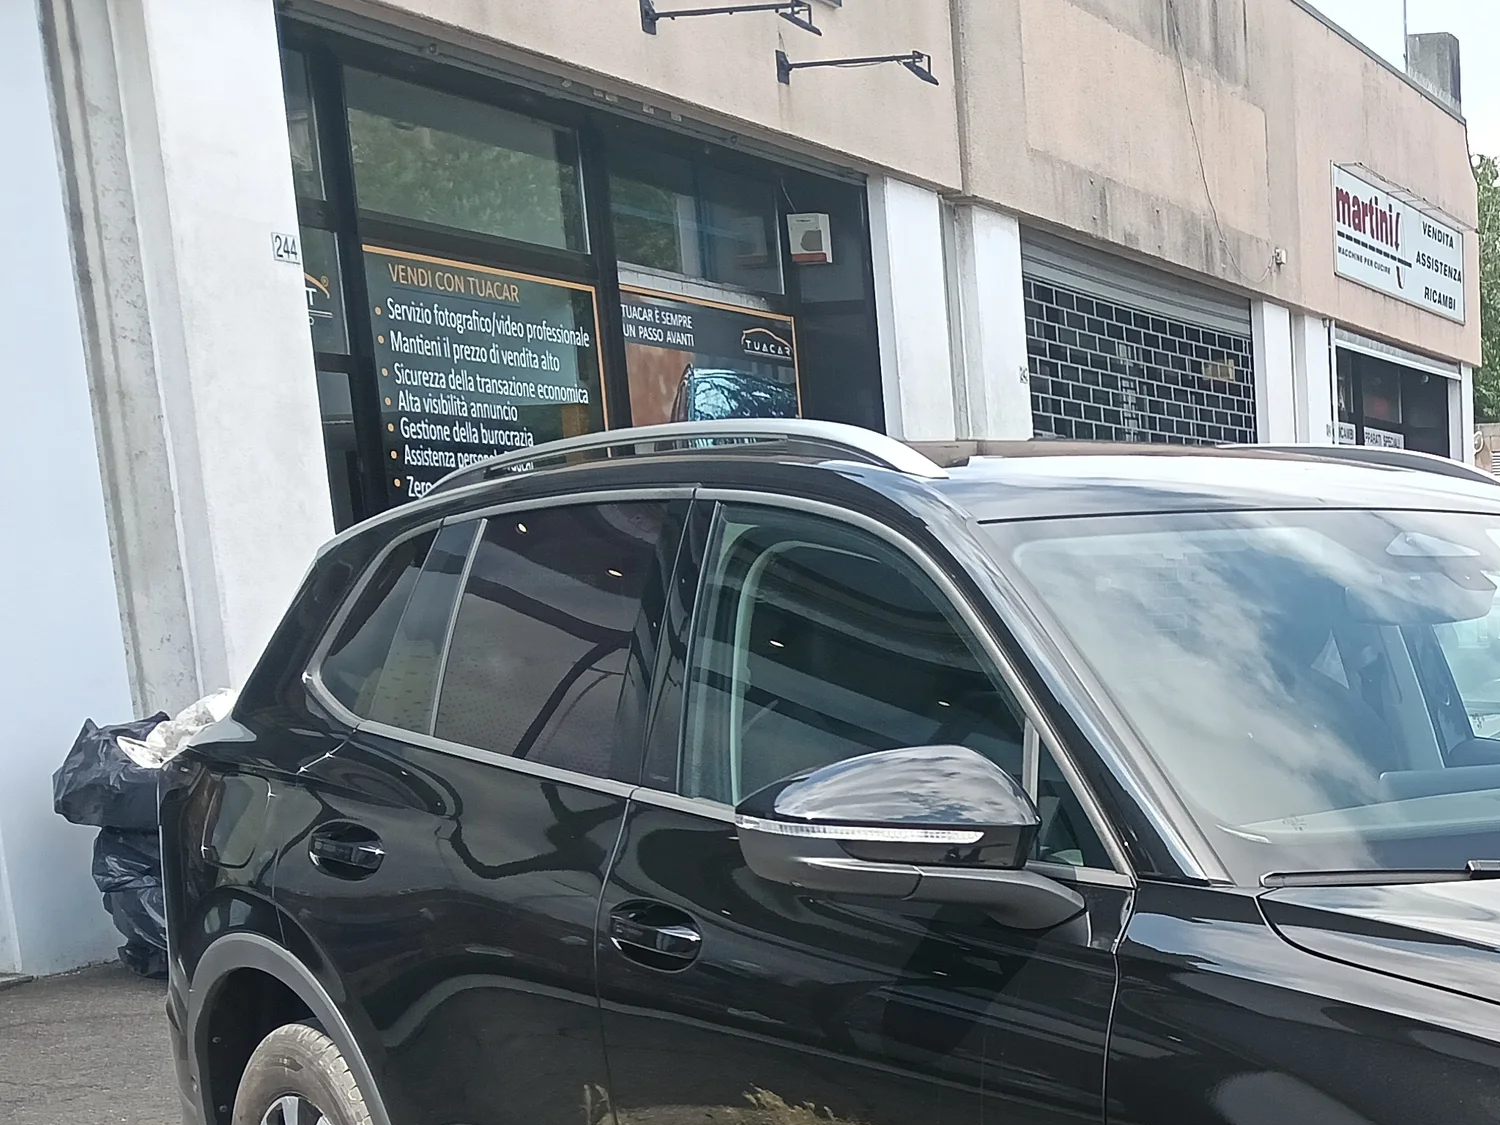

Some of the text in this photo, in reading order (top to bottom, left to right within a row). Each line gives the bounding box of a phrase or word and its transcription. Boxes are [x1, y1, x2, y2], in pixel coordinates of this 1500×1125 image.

[1335, 186, 1393, 246] martini
[274, 235, 297, 260] 244
[1422, 221, 1454, 249] VENDITA
[1416, 251, 1462, 283] ASSISTENZA
[388, 263, 519, 303] VENDI CON TUACAR
[1424, 286, 1456, 311] RICAMBI
[387, 298, 590, 348] Servizio fotografico/video professionale
[621, 304, 693, 330] TUACAR È SEMPRE
[623, 324, 694, 347] UN PASSO AVANTI
[745, 339, 791, 356] TUACAR
[390, 331, 560, 372] Mantieni il prezzo di vendita alto
[394, 363, 589, 404] Sicurezza della transazione economica
[398, 390, 518, 422] Alta visibilità annuncio
[400, 418, 534, 448] Gestione della burocrazia
[404, 444, 456, 467] Assistenza
[406, 475, 433, 498] Zero
